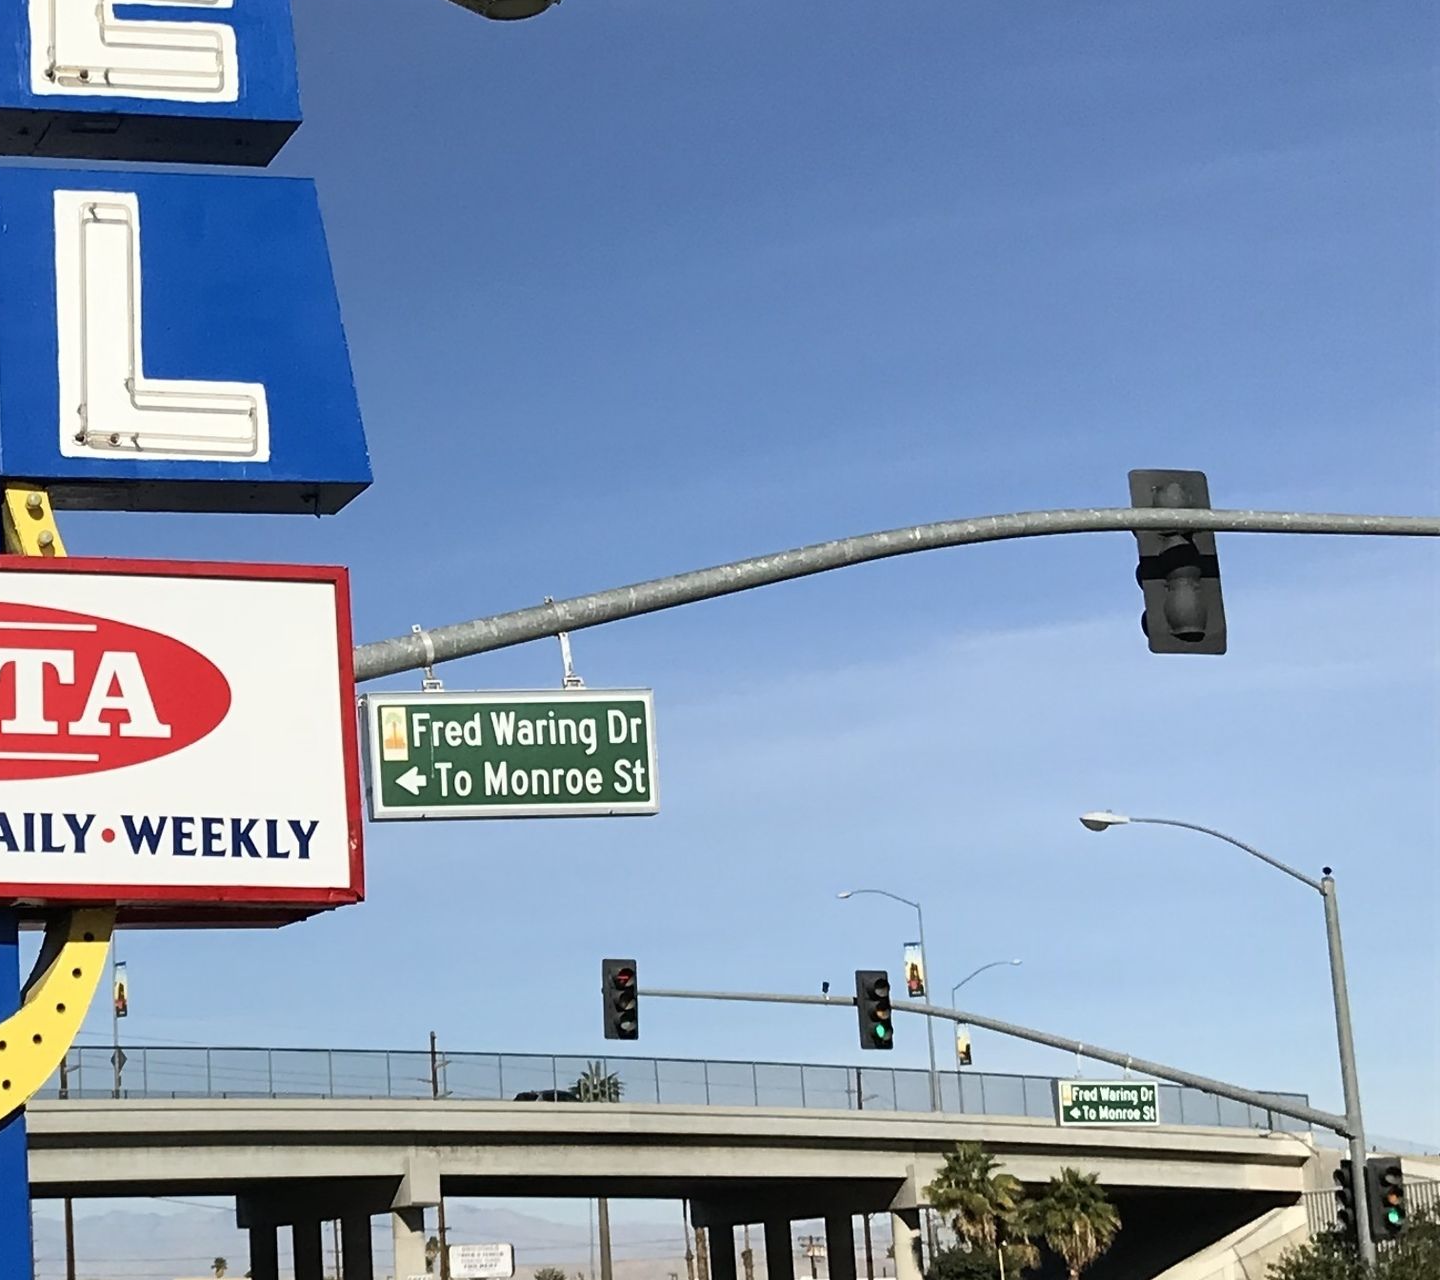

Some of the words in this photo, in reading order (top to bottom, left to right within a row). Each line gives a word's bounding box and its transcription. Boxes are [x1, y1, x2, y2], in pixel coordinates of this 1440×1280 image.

[412, 712, 482, 748] Fred
[490, 711, 597, 755] Waring
[607, 709, 642, 744] Dr
[434, 762, 472, 796] To
[484, 761, 603, 796] Monroe
[613, 758, 646, 794] St
[120, 814, 320, 860] WEEKLY
[1072, 1086, 1098, 1101] Fred
[1099, 1086, 1138, 1106] Waring
[1140, 1086, 1154, 1101] Dr
[1082, 1105, 1097, 1120] To
[1098, 1105, 1141, 1120] Monroe
[1142, 1105, 1155, 1120] St
